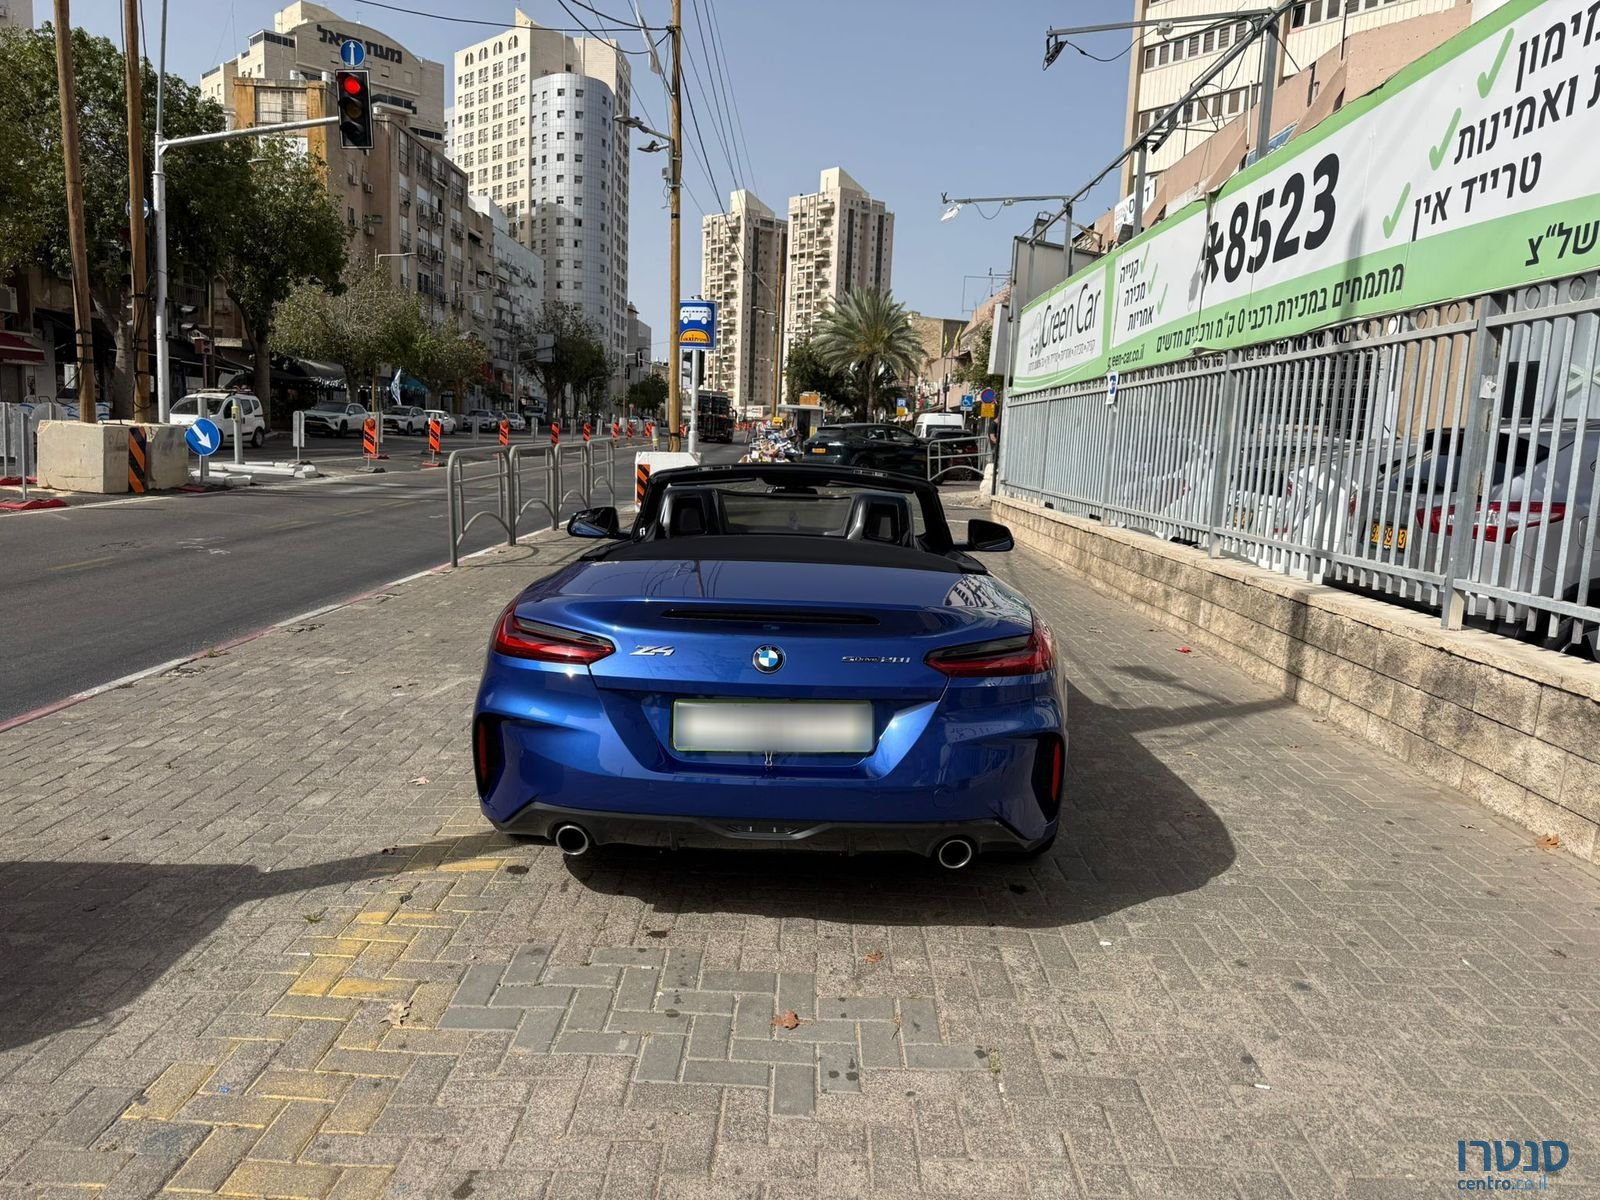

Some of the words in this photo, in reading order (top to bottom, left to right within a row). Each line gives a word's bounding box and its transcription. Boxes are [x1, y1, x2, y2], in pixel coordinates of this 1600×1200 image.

[1454, 75, 1579, 165] ואמינות
[1461, 152, 1542, 213] טרייד
[1411, 186, 1452, 242] אין
[1120, 259, 1139, 283] קנייה
[1124, 282, 1146, 307] מכירה
[1333, 263, 1404, 306] מתמחים
[1042, 304, 1074, 348] Green
[1076, 283, 1101, 334] Car
[1127, 305, 1154, 331] אחריות
[1248, 304, 1273, 330] רכבי
[1275, 288, 1328, 323] במכירת
[1238, 308, 1246, 333] 0
[1157, 330, 1183, 352] חדשים
[629, 645, 676, 657] Z4
